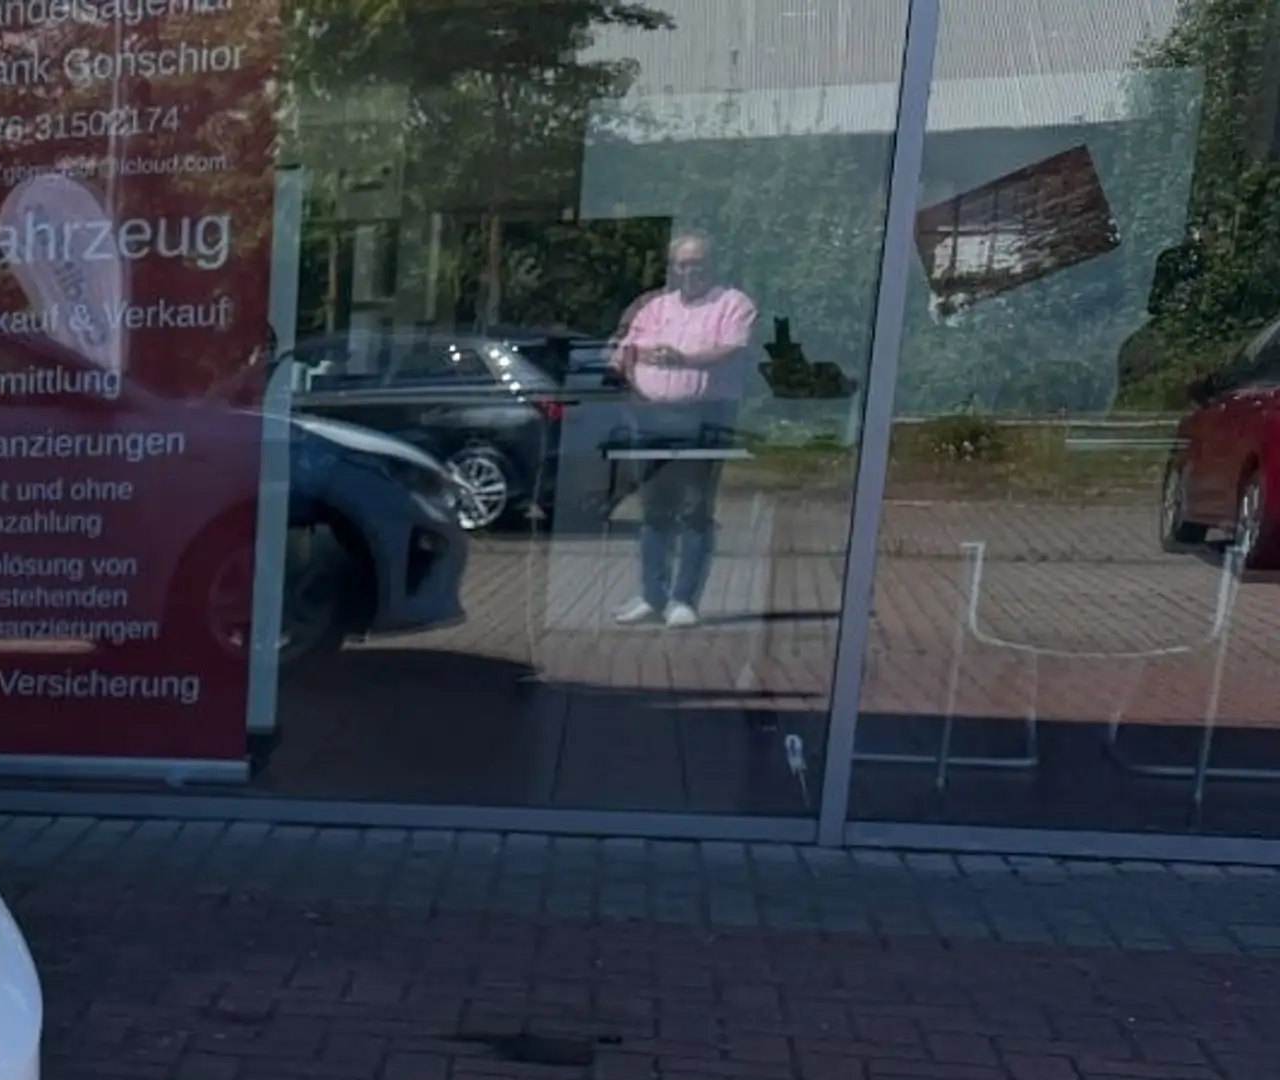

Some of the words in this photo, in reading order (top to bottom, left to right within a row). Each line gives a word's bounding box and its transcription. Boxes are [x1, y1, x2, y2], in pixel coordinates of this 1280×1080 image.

[63, 40, 246, 81] Gonschior
[68, 304, 93, 331] &
[104, 297, 231, 329] Verkauf
[16, 479, 63, 500] und
[70, 477, 134, 500] ohne
[91, 560, 137, 576] von
